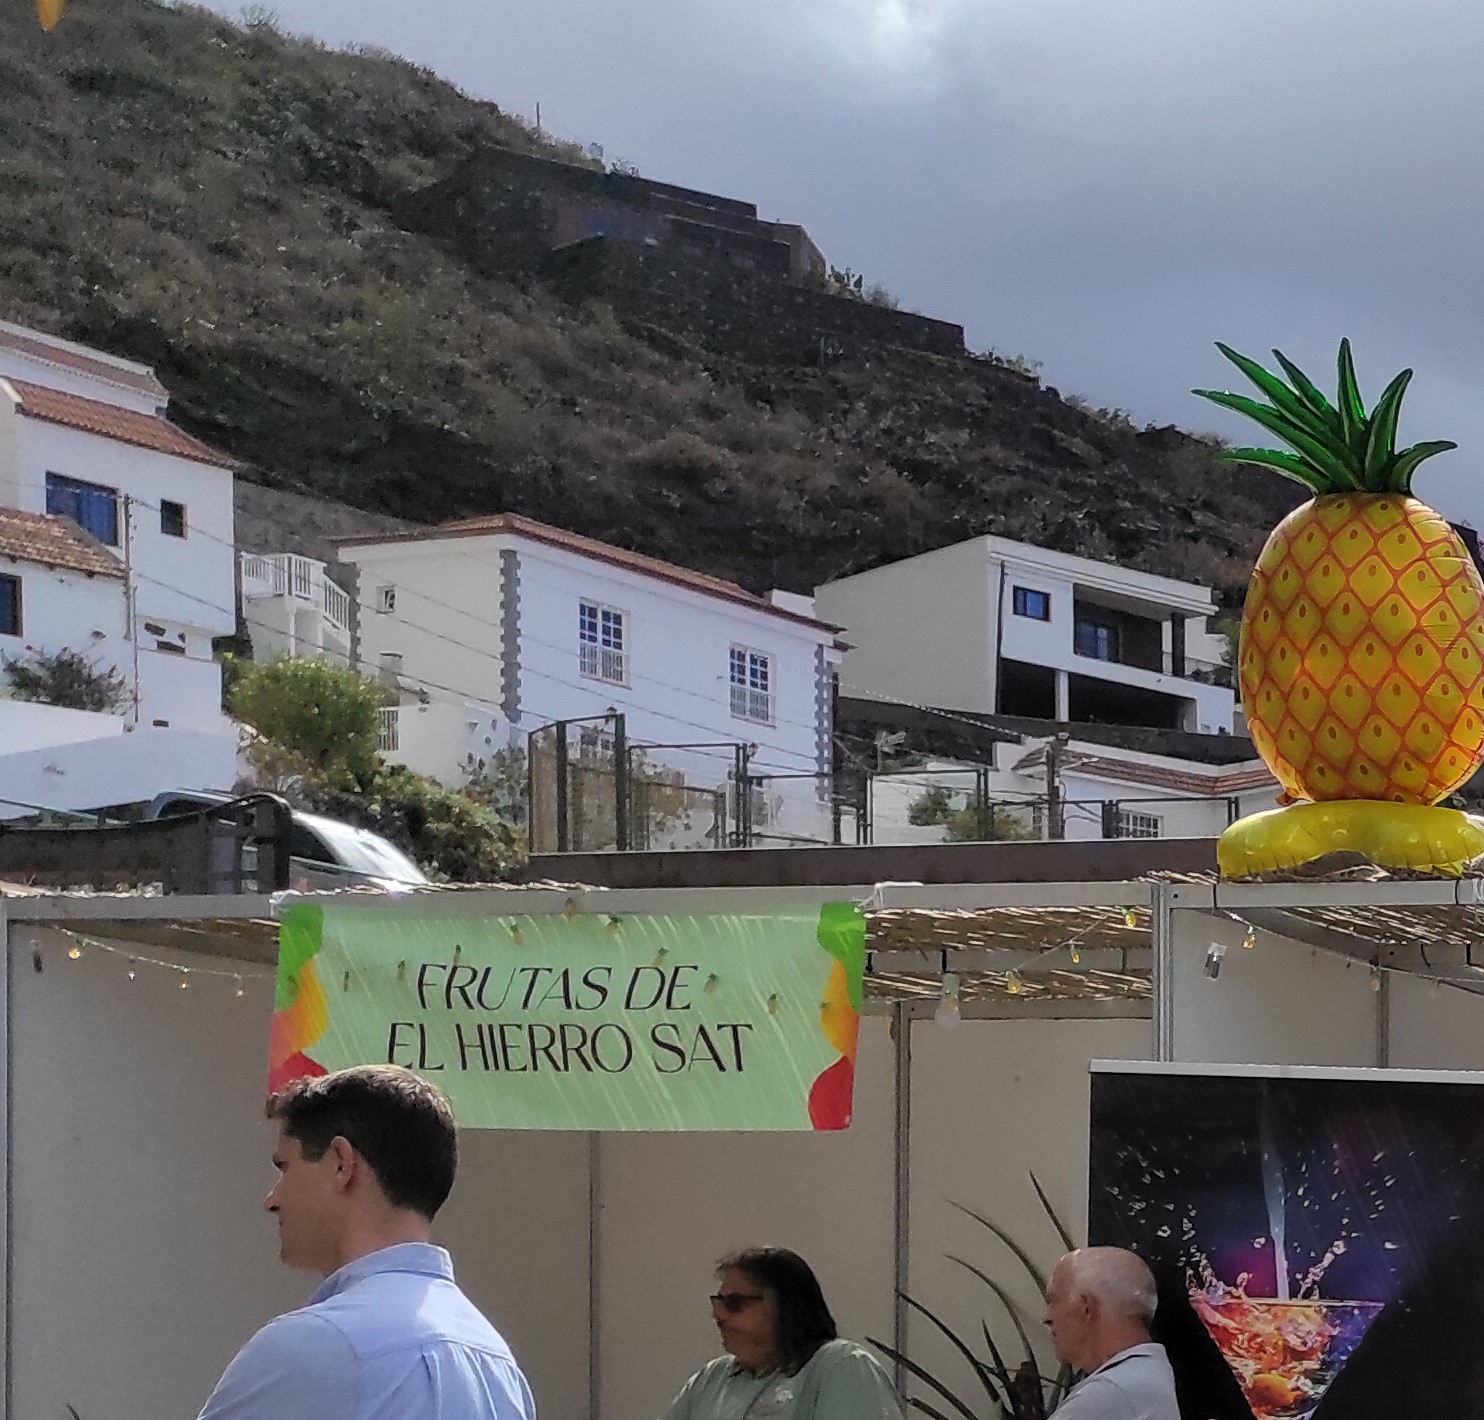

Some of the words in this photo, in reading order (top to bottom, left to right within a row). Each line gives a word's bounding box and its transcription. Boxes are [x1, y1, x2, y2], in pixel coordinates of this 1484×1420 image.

[416, 963, 612, 1011] FRUTAS
[624, 963, 700, 1011] DE
[387, 1021, 445, 1072] EL
[455, 1022, 634, 1073] HIERRO
[651, 1022, 753, 1075] SAT
